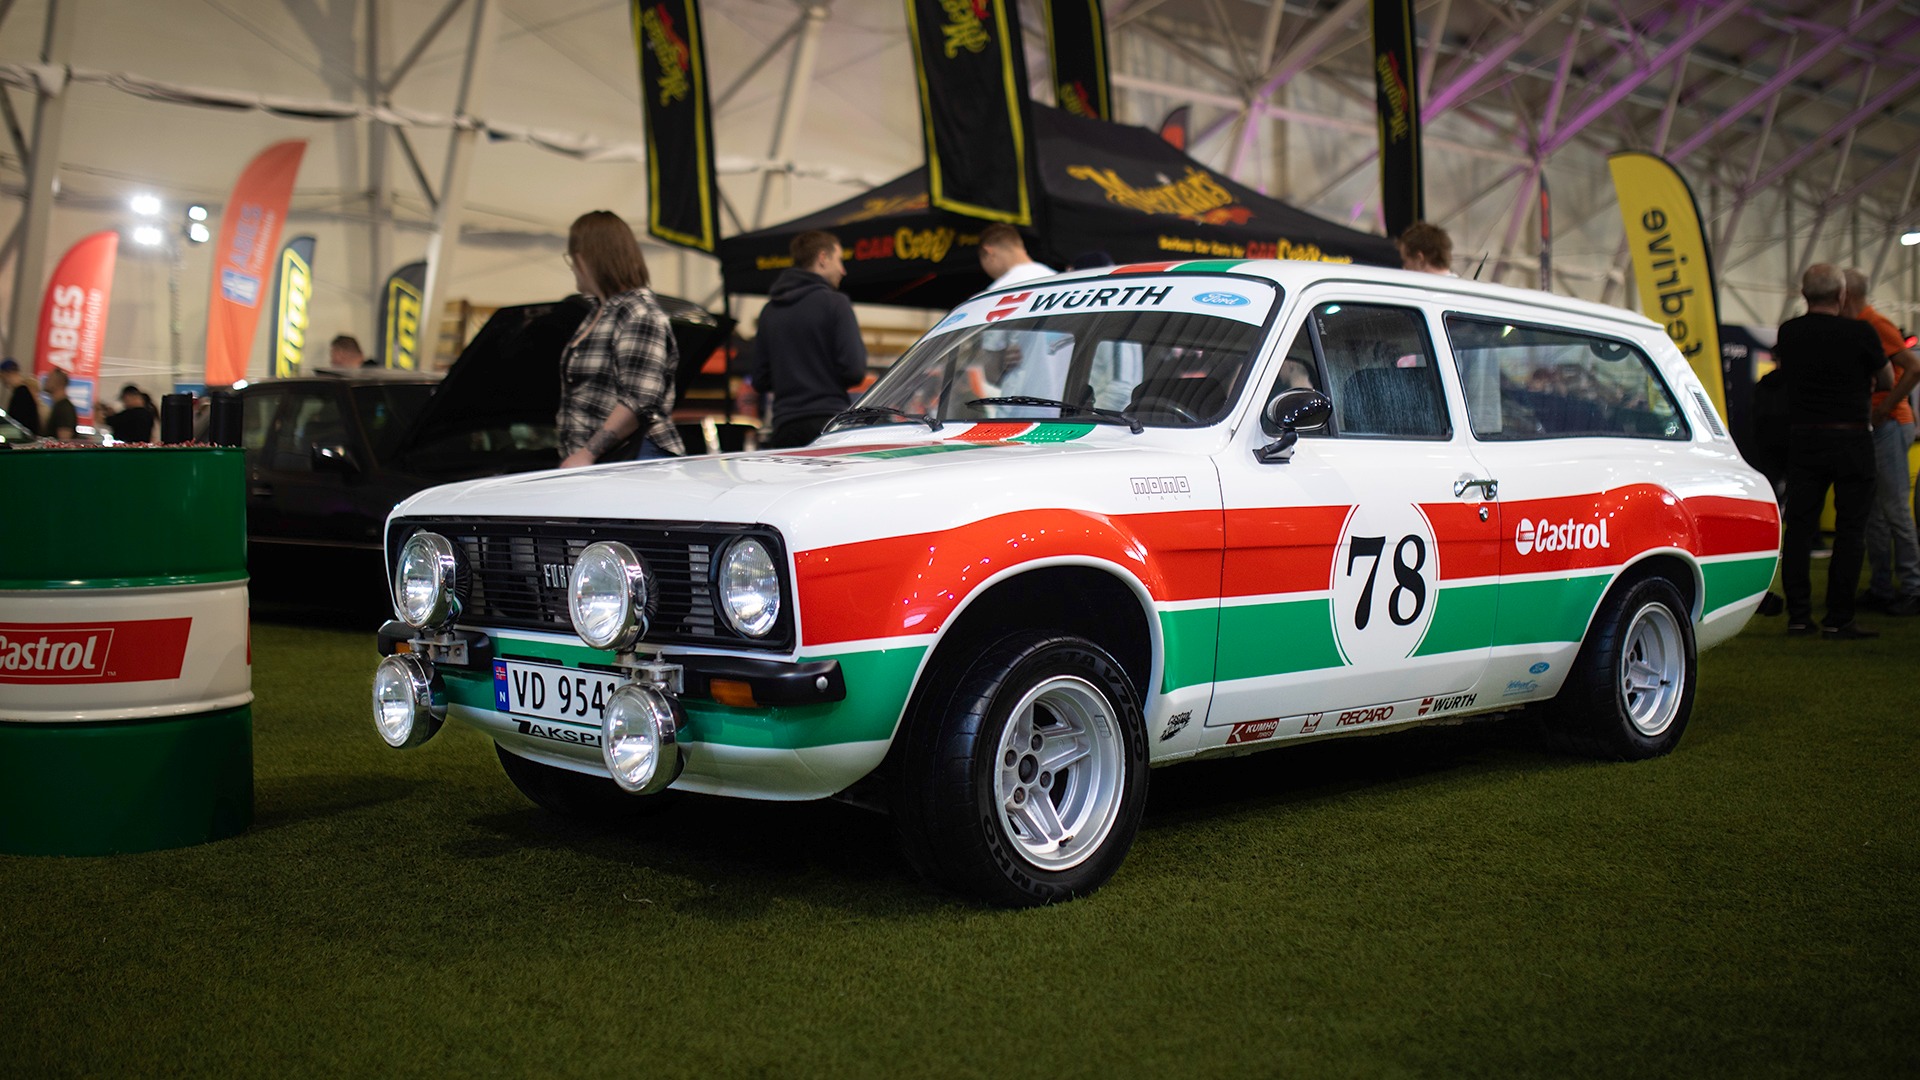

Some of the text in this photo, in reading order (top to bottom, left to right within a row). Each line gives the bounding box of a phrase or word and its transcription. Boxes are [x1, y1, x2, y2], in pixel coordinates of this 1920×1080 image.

[854, 235, 895, 260] CAR
[1027, 286, 1175, 313] WÜRTH
[47, 284, 85, 374] ABES
[1535, 518, 1610, 553] Castrol
[1346, 534, 1427, 631] 78
[499, 691, 506, 703] N
[513, 670, 546, 710] VD
[1432, 693, 1478, 713] WÜRTH
[1245, 720, 1278, 734] KUMHO
[1336, 705, 1394, 727] RECARO
[983, 815, 1068, 895] UMHO
